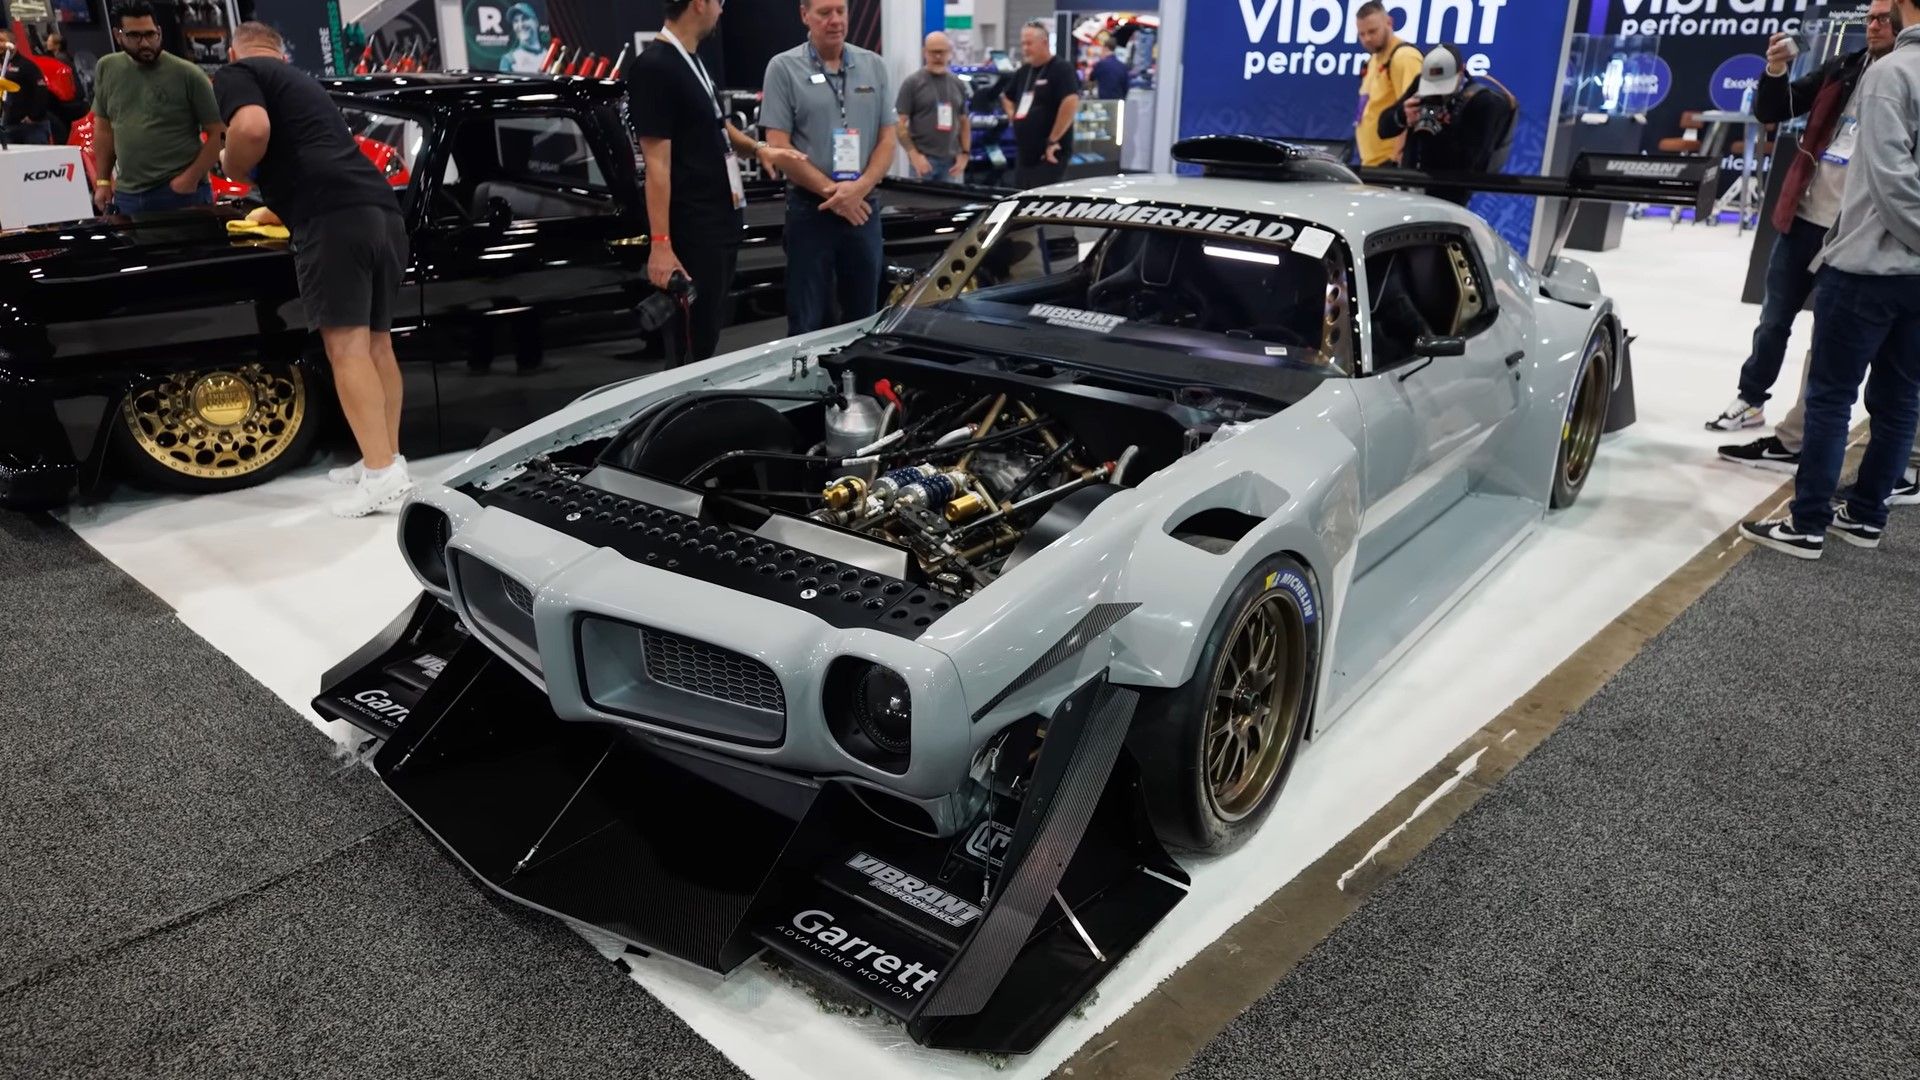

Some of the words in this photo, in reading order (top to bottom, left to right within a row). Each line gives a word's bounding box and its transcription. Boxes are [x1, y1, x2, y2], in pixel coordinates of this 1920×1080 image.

[478, 6, 503, 34] R
[1244, 46, 1491, 80] perfore
[24, 168, 66, 182] KONI
[1018, 201, 1294, 241] HAMMERHEAD
[1028, 303, 1128, 326] VIBRANT
[1280, 573, 1314, 617] MICHELIN
[354, 689, 410, 722] Garr
[846, 852, 984, 922] VIBRANT
[869, 879, 966, 927] PERFORMANCE
[775, 925, 854, 968] ADVANCING
[857, 967, 914, 999] MOTION
[792, 909, 939, 992] Garrett
